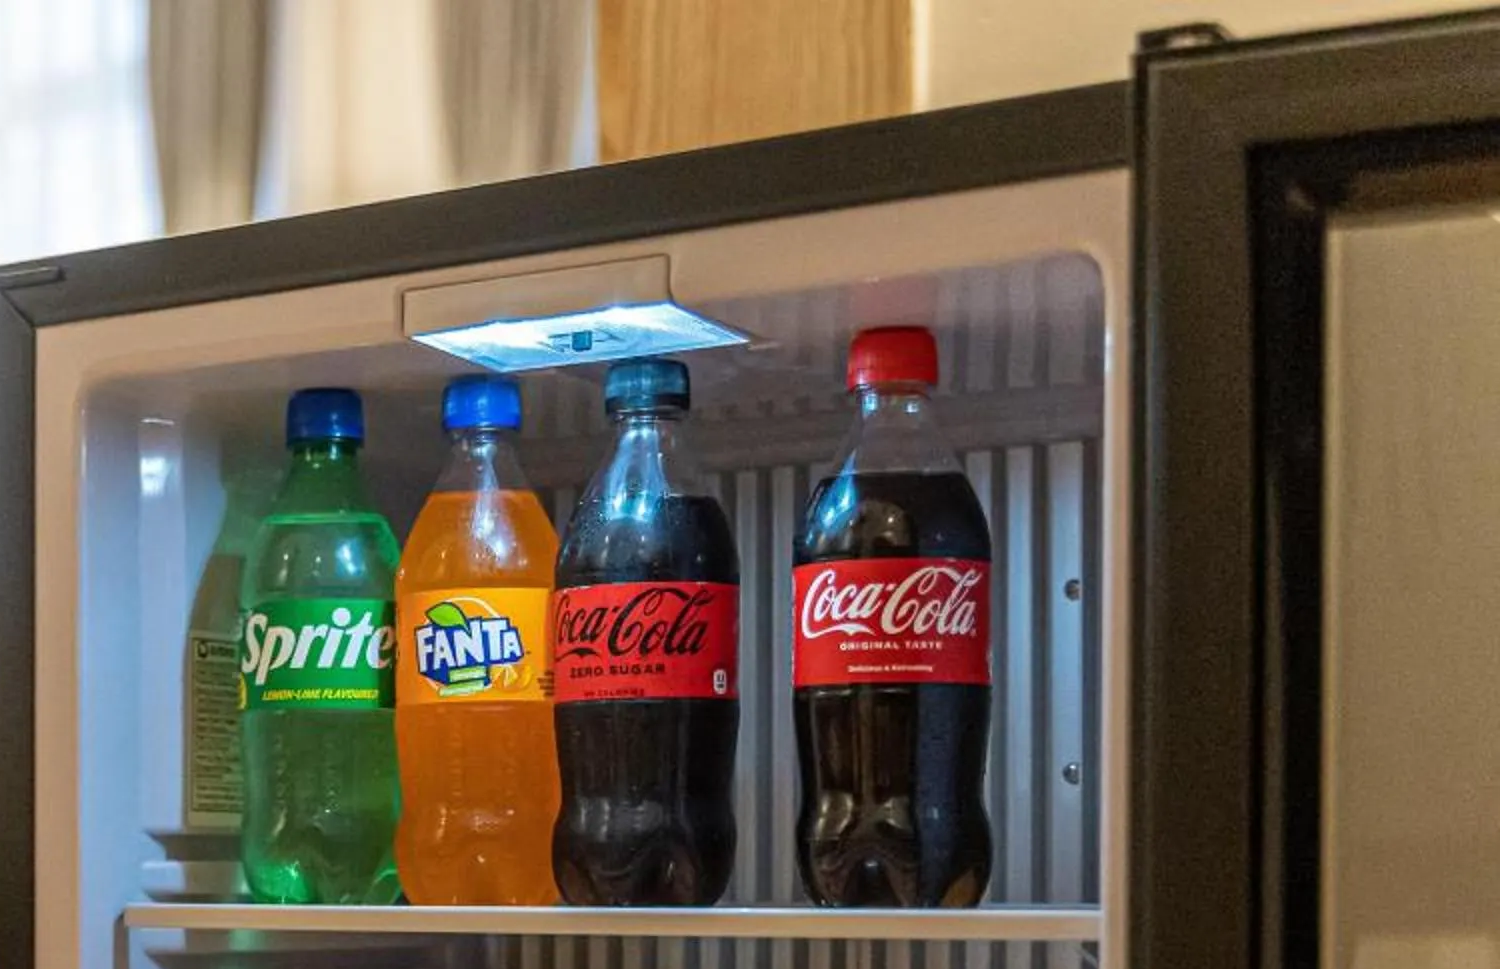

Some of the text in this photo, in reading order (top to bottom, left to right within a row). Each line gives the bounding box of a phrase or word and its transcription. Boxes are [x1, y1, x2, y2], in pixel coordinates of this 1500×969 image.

[801, 566, 983, 639] Coca-Cola
[241, 607, 394, 685] Sprite
[416, 619, 521, 673] FANTA
[570, 663, 666, 679] ZERO SUGAR
[839, 640, 942, 651] ORIGINAL TASTE
